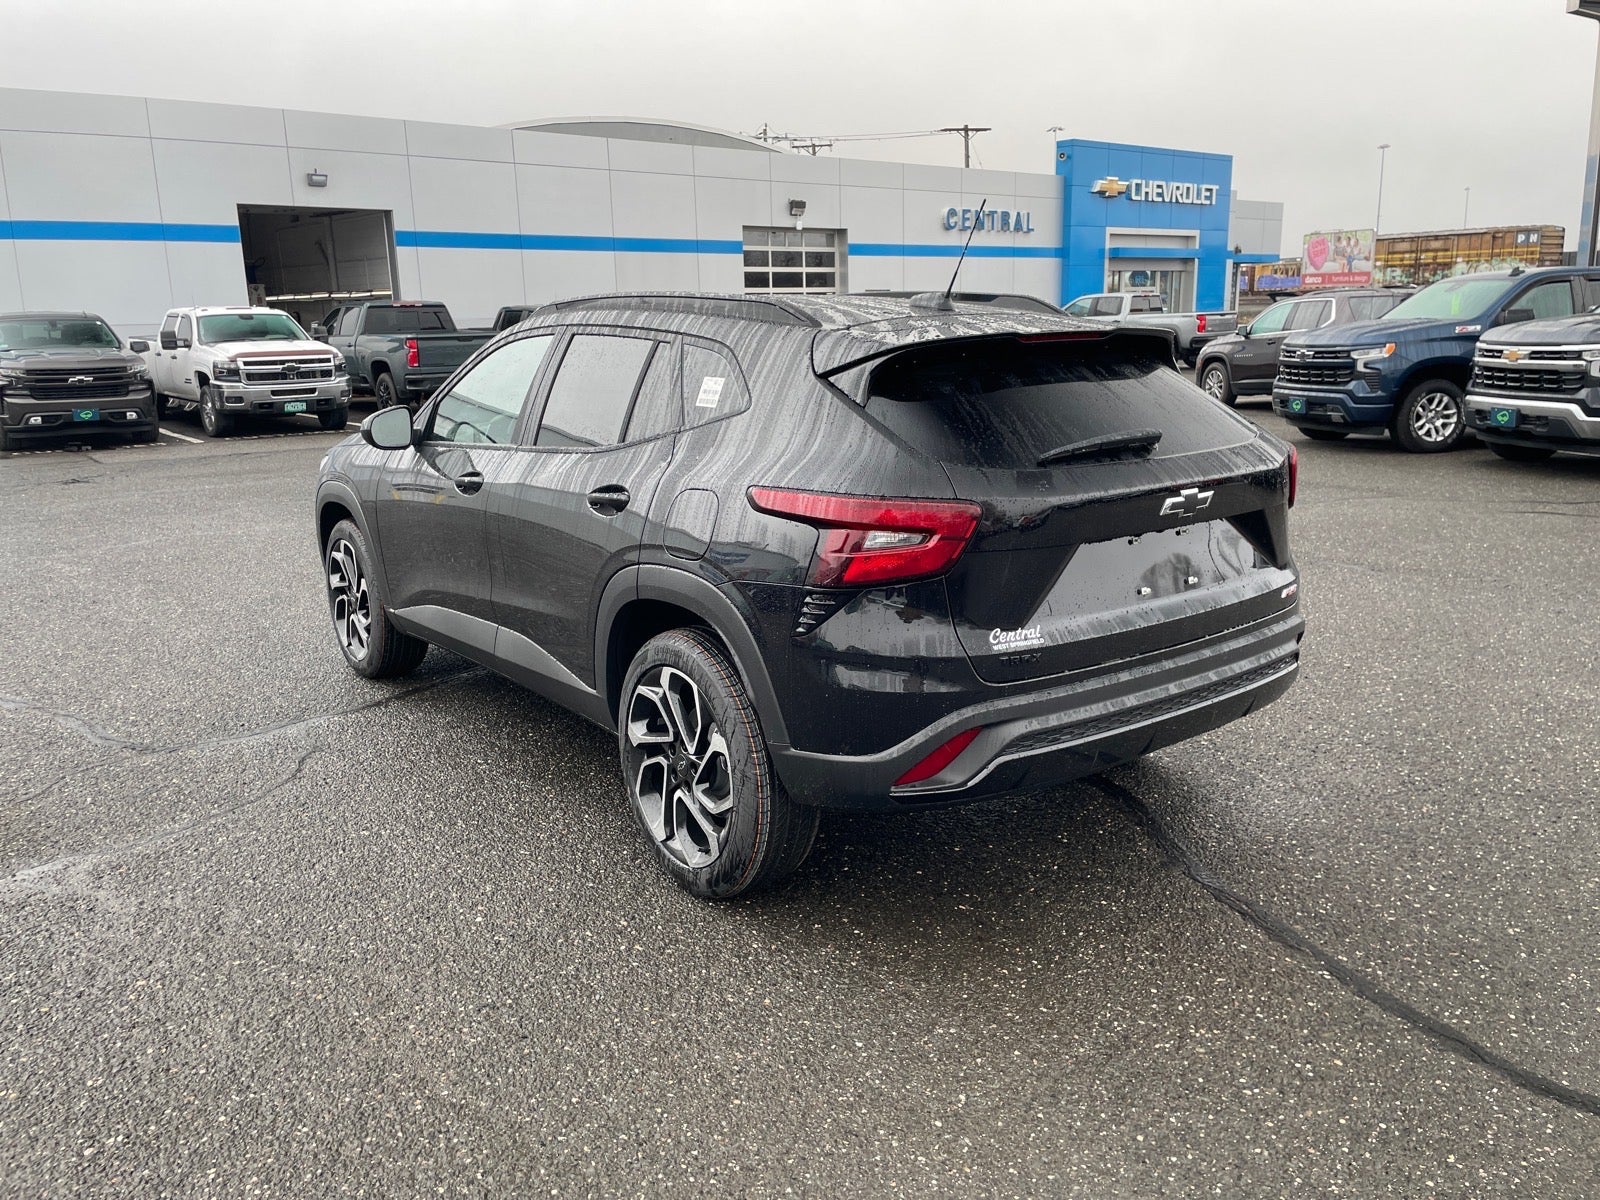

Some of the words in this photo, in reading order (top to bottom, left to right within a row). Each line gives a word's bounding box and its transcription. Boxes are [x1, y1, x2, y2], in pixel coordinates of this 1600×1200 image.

[1130, 179, 1219, 205] CHEVROLET
[943, 207, 1035, 234] CENTRAL
[989, 624, 1041, 644] Central
[992, 642, 1009, 651] WEST
[1009, 637, 1045, 648] SPRINGFIELD
